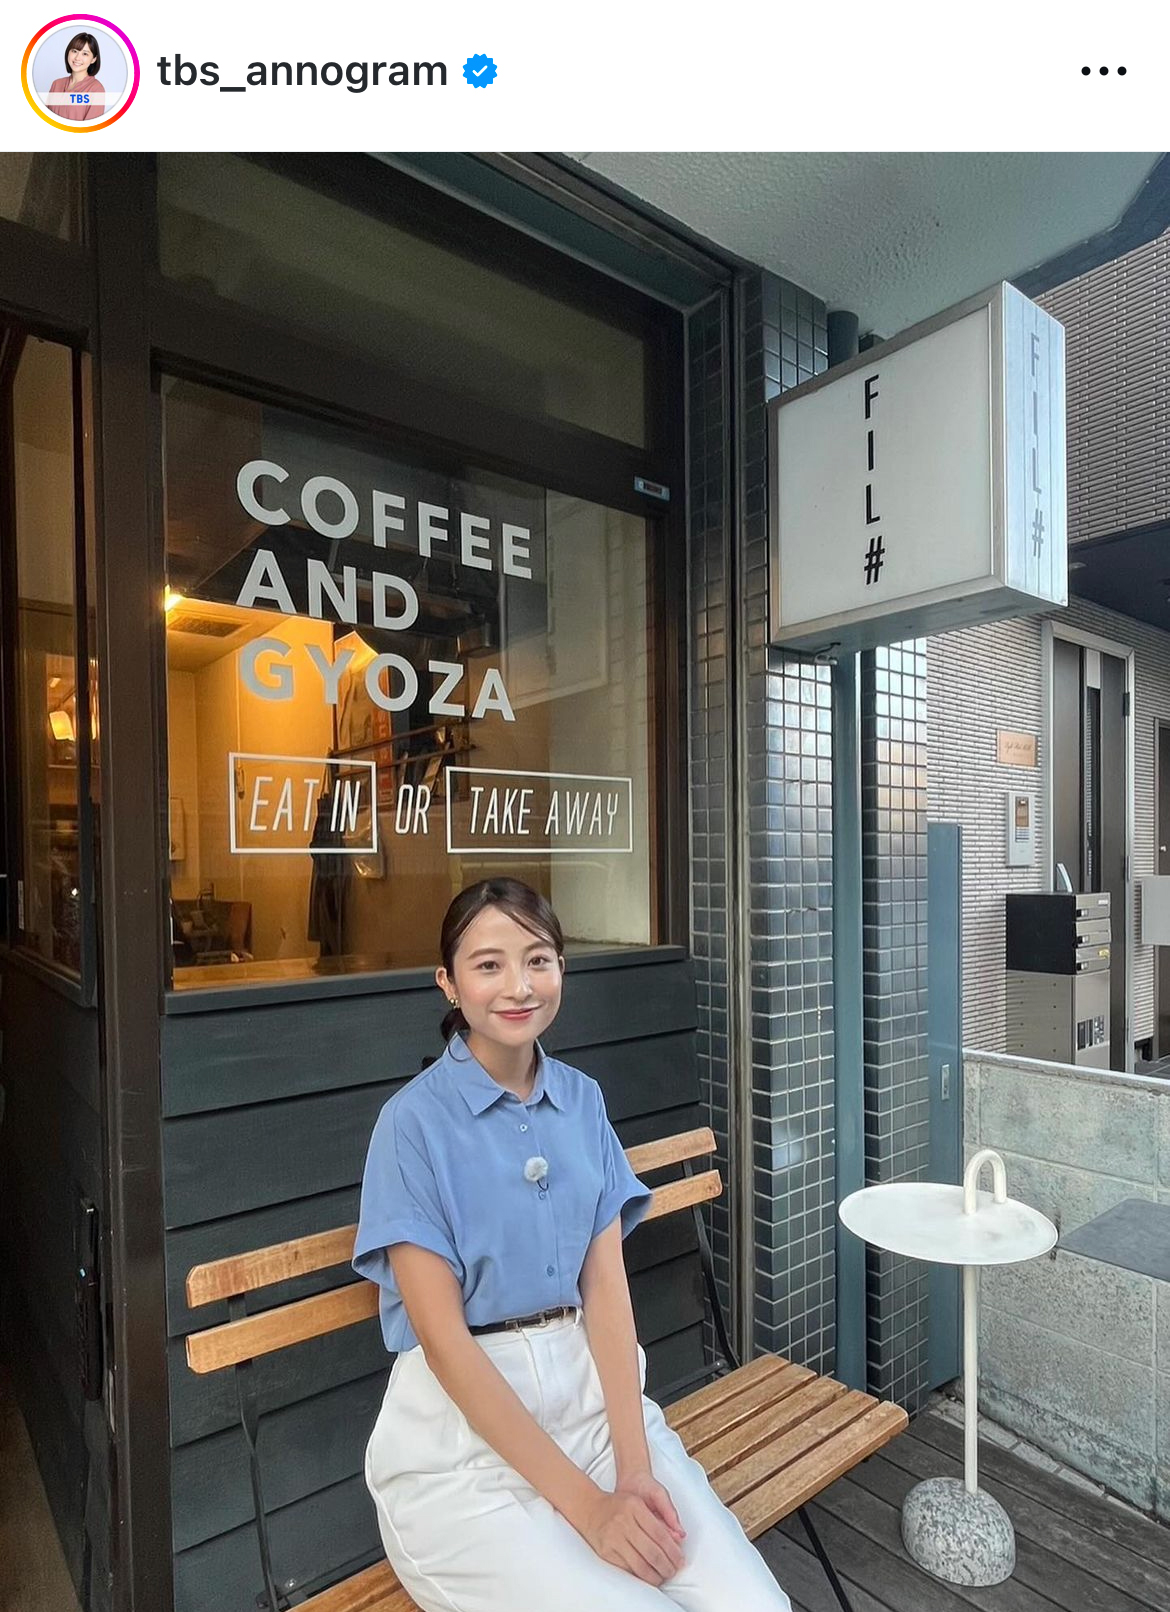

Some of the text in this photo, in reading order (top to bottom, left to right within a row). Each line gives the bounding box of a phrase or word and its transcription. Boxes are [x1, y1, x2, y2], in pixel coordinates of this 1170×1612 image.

[236, 460, 532, 579] COFFEE
[863, 374, 886, 585] FIL#
[236, 549, 419, 631] AND
[239, 636, 515, 721] GYOZA
[250, 776, 618, 835] EAT IN OR TAKE AWAY
